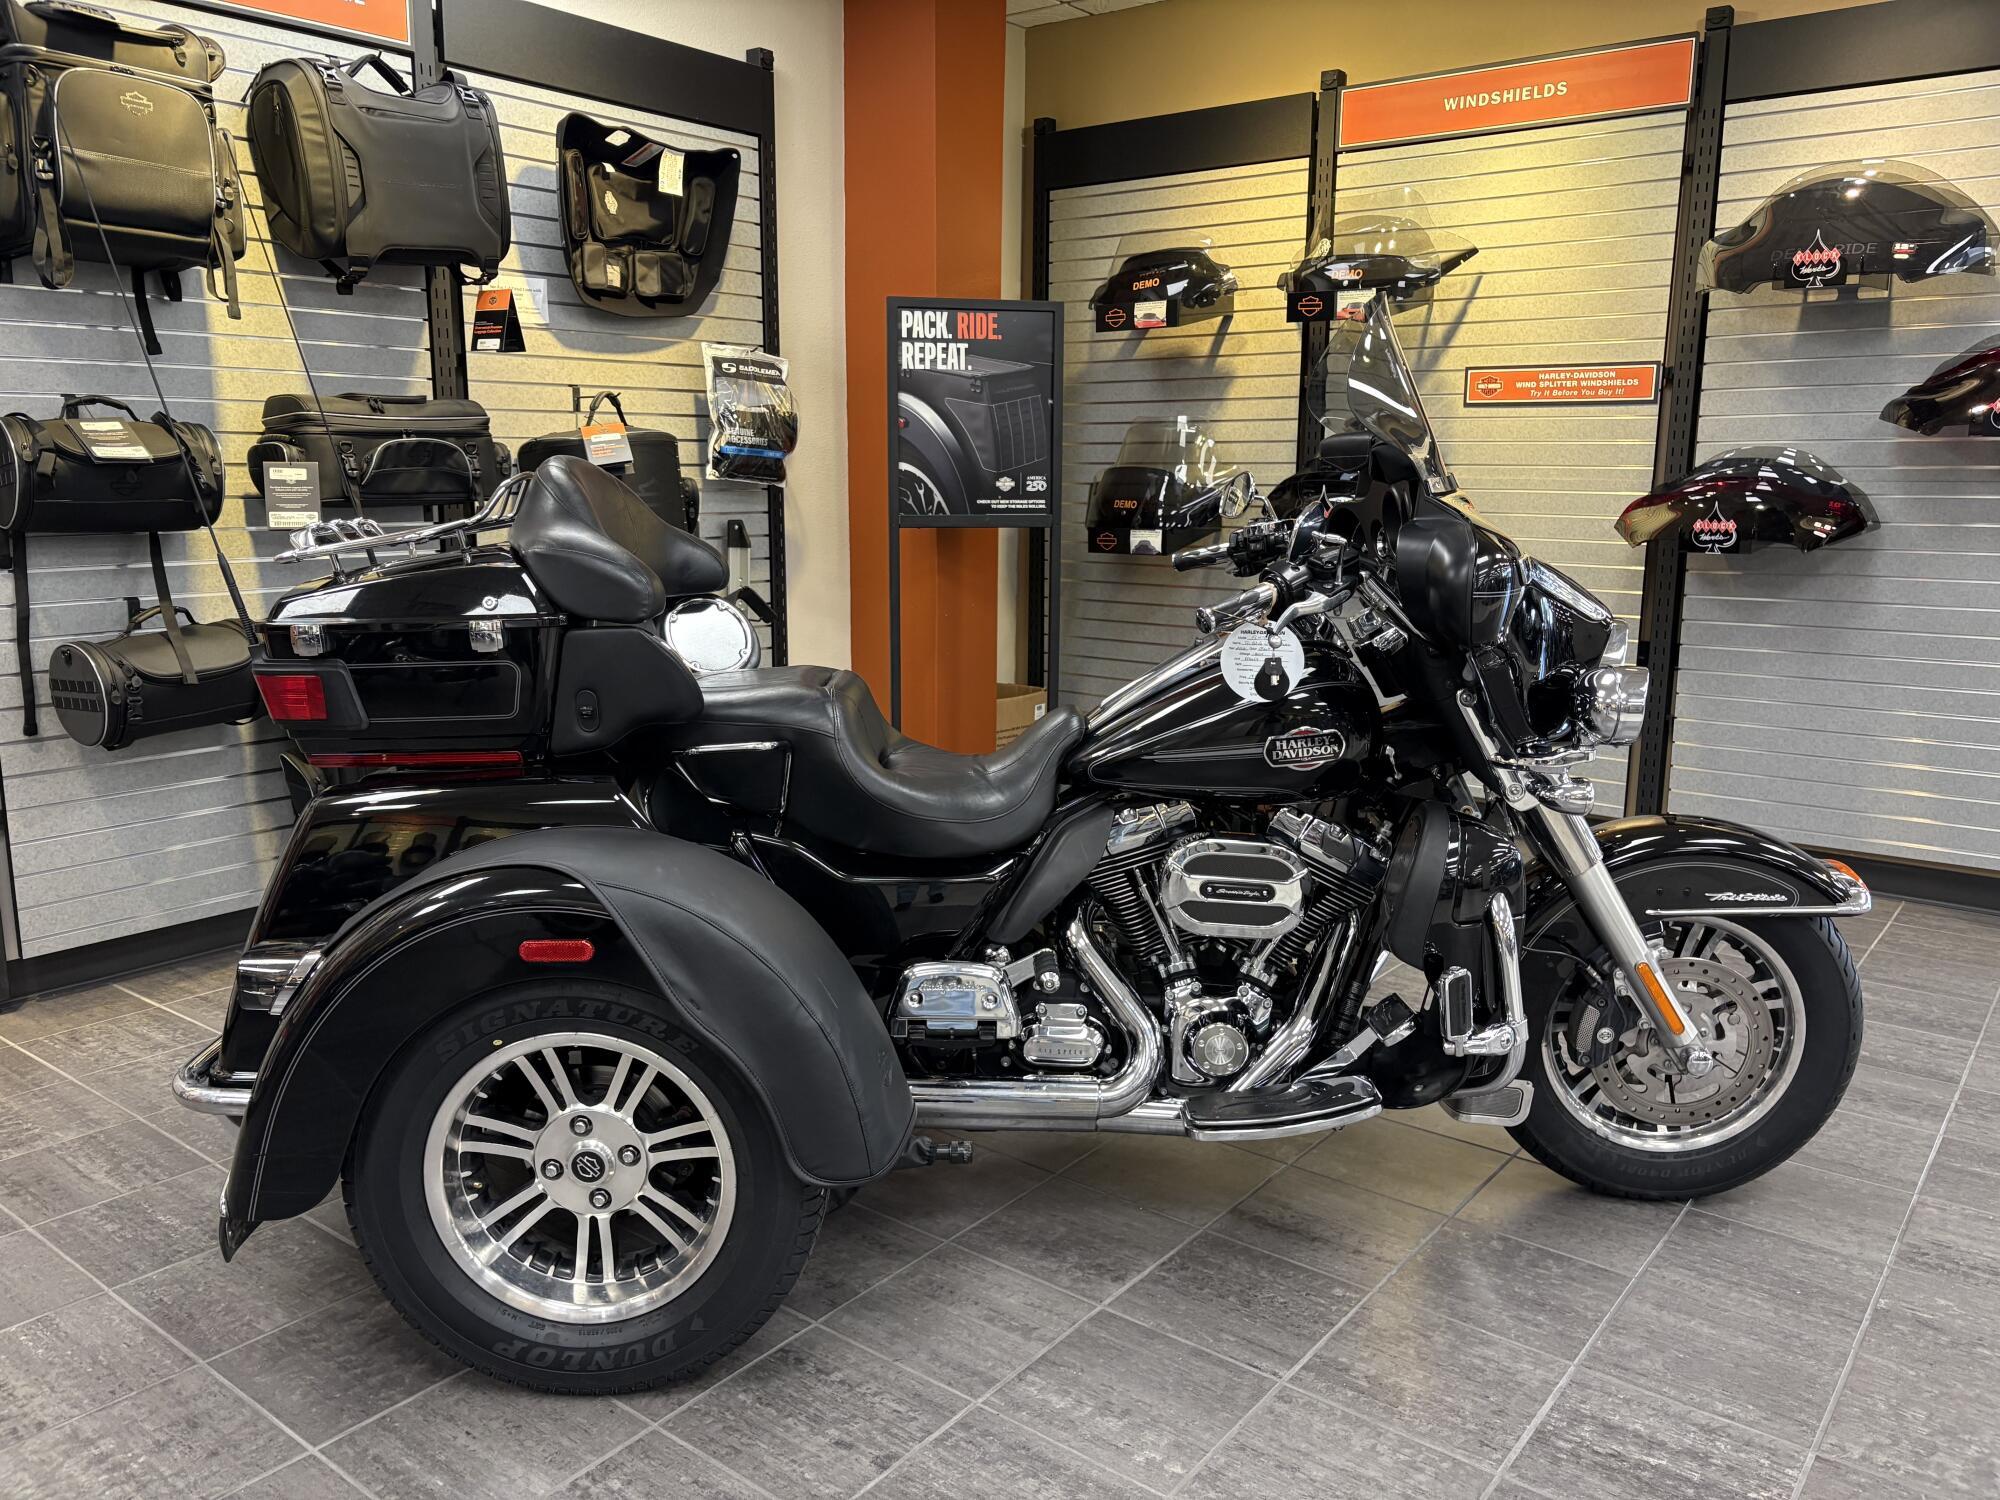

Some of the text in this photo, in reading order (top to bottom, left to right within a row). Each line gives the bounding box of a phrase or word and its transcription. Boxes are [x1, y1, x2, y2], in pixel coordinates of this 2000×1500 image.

[1443, 81, 1568, 111] WINDSHIELDS
[1794, 249, 1840, 264] KLOCK
[1331, 269, 1364, 280] DEMO
[1132, 277, 1161, 291] DEMO
[901, 310, 1003, 340] PACK. RIDE.
[901, 341, 973, 371] REPEAT.
[1538, 371, 1616, 380] HARLEY-DAVIDSON
[1515, 378, 1639, 389] WIND SPLITTER WINDSHIELDS
[1529, 389, 1542, 398] Try
[1552, 389, 1579, 397] Before
[1580, 388, 1596, 396] You
[1598, 388, 1613, 397] Buy
[1615, 388, 1625, 396] It!
[1026, 480, 1047, 491] 250
[1113, 499, 1138, 509] DEMO
[1694, 520, 1736, 532] KLOCK
[1275, 736, 1335, 750] HARLEY-
[1272, 744, 1340, 760] DAVIDSON
[434, 1000, 700, 1055] SIGNATURE
[491, 1329, 678, 1371] DUNLOP
